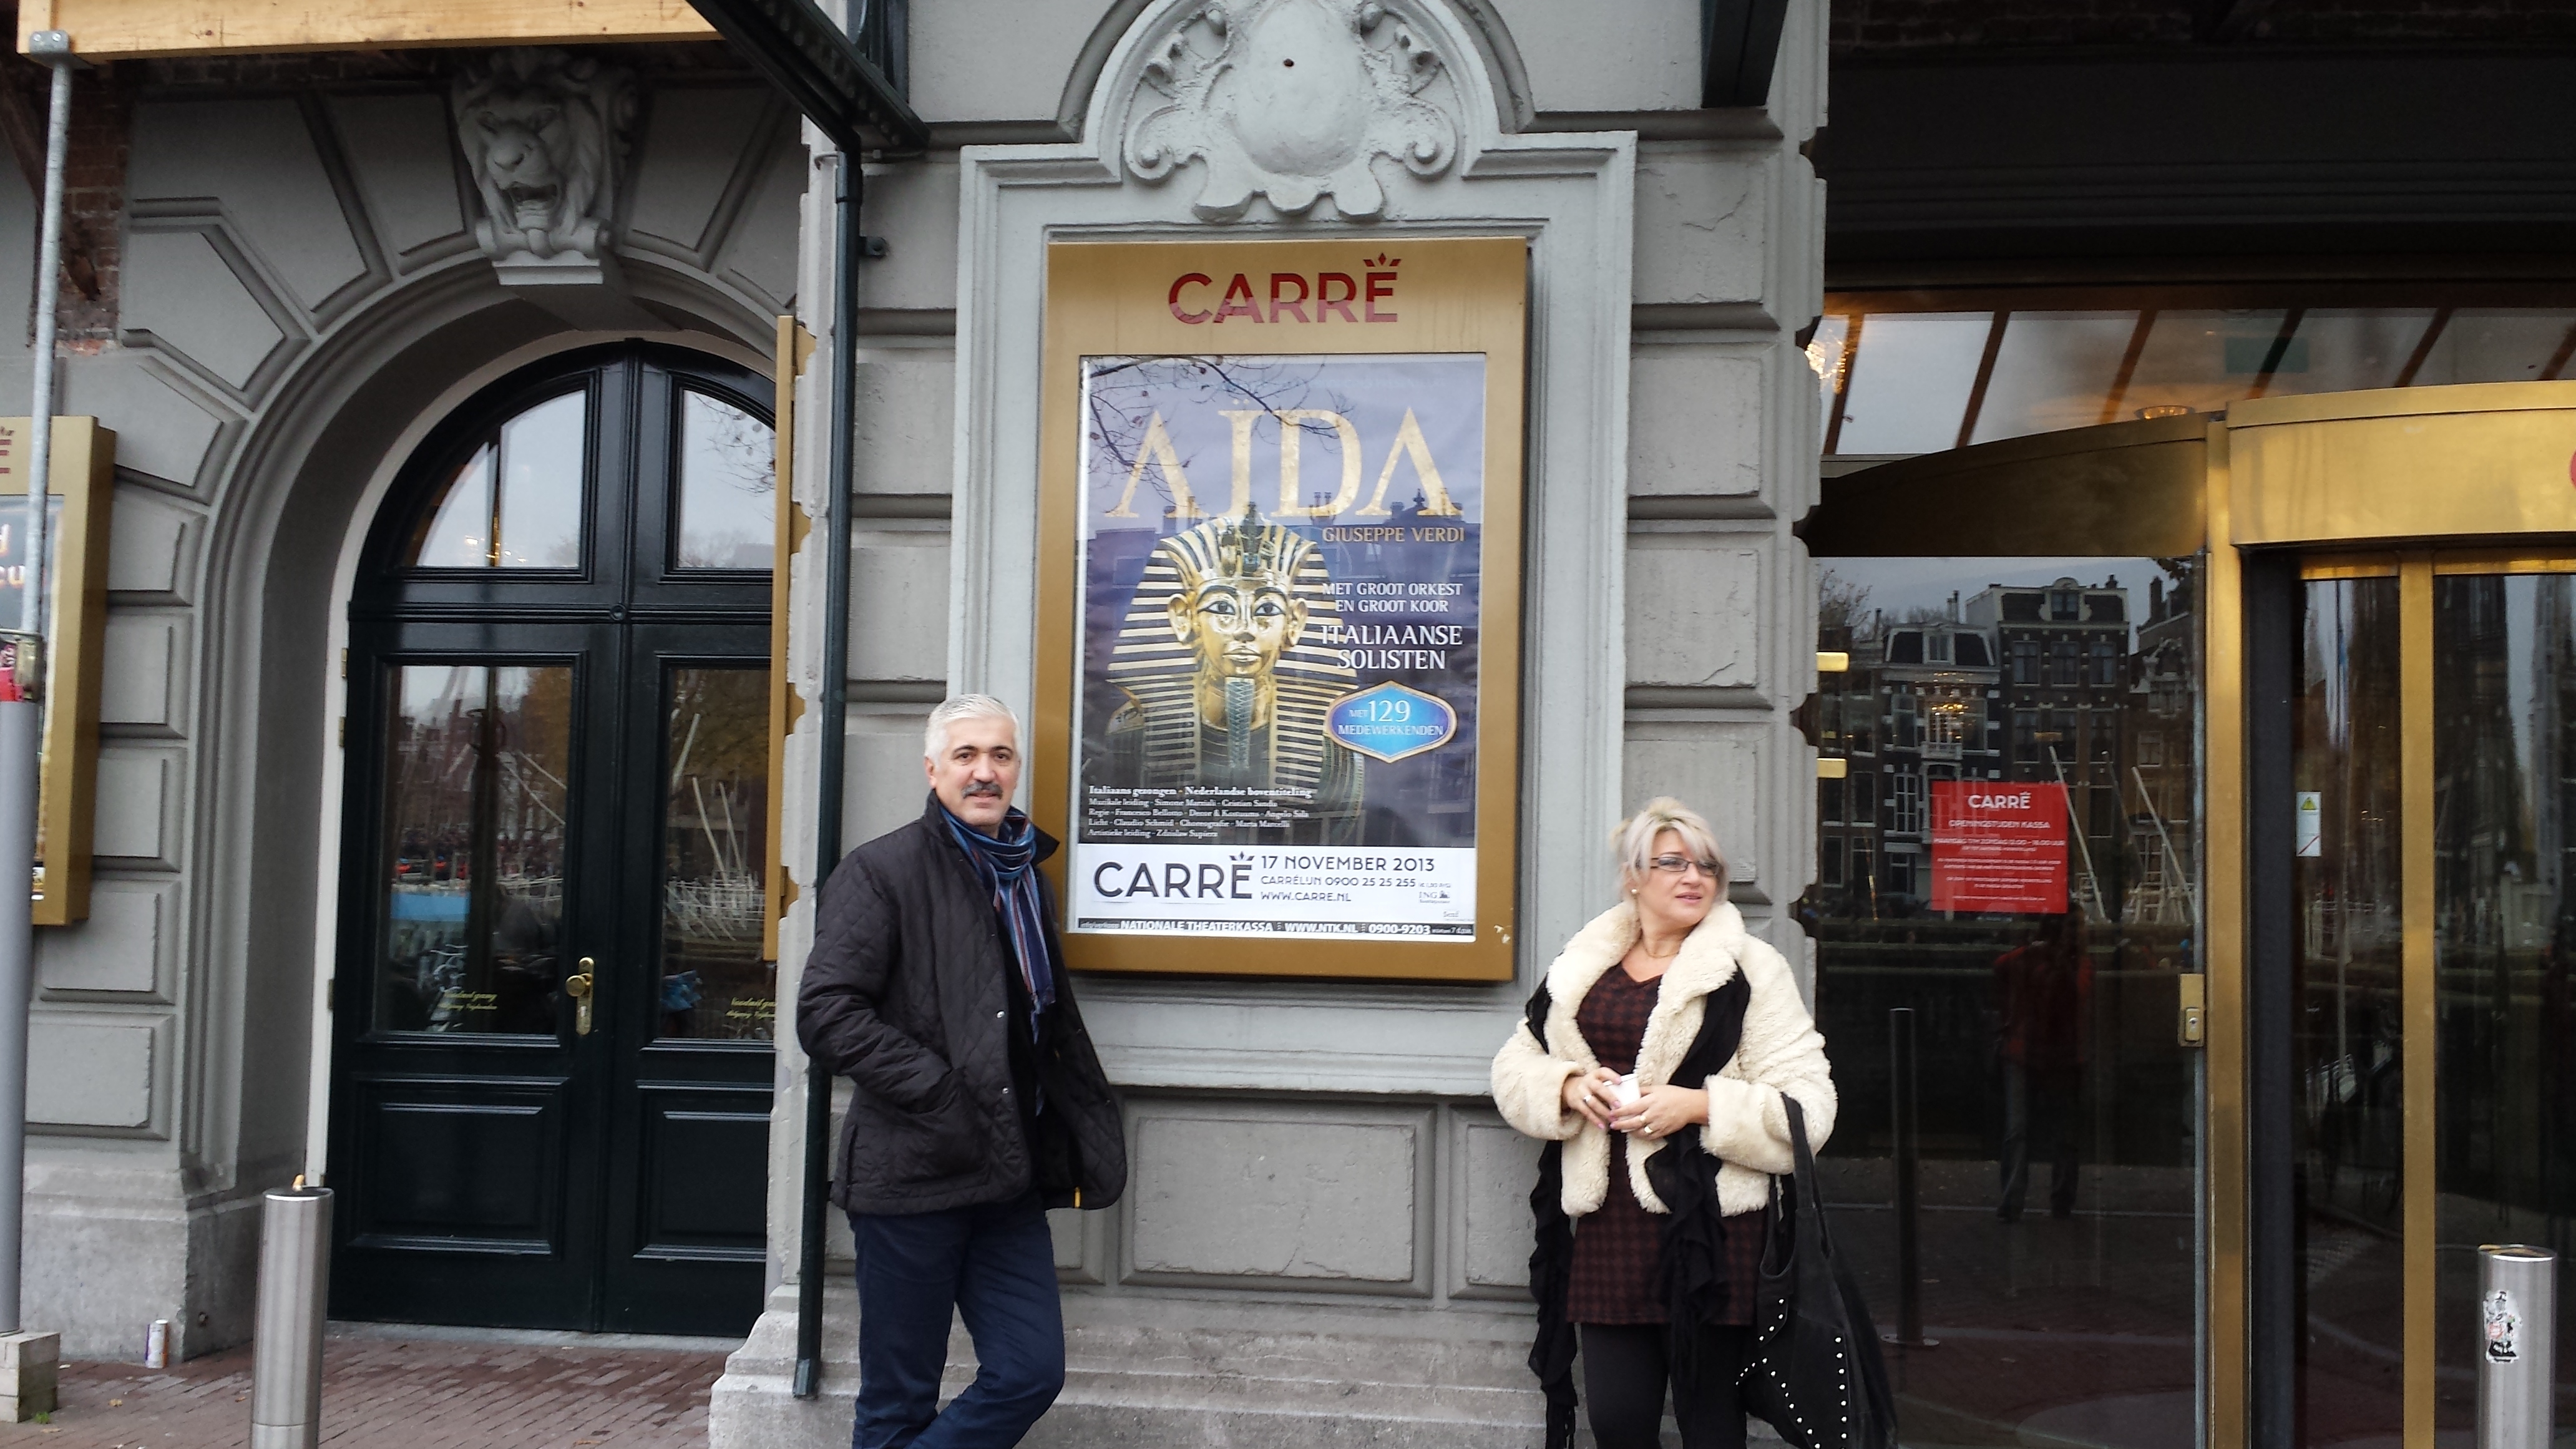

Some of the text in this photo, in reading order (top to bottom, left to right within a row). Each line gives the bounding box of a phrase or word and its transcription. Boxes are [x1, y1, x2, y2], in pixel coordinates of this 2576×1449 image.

[1322, 527, 1465, 542] GIUSEPPE VERDI
[1322, 583, 1463, 596] MET GROOT ORKEST
[1335, 600, 1448, 613] EN GROOT KOOR
[1321, 625, 1463, 645] ITALIAANSE
[1337, 650, 1446, 670] SOLISTEN
[1349, 700, 1412, 723] MET 129
[1338, 724, 1444, 736] MEDEWERKENDEN
[1088, 785, 1132, 795] Italiaans
[1184, 786, 1246, 796] Nederlandse
[1261, 855, 1435, 872] 17 NOVEMBER 2013
[1325, 877, 1359, 886] 0900
[1362, 877, 1375, 887] 25
[1379, 878, 1392, 887] 25
[1395, 878, 1416, 887] 255
[1261, 891, 1352, 902] WWW.CARRE.NL
[1121, 920, 1184, 931] NATIONALE
[1185, 921, 1274, 932] THEATERKASSA
[1284, 922, 1359, 933] WWW.NTK.NL
[1367, 924, 1432, 935] 0900-9203
